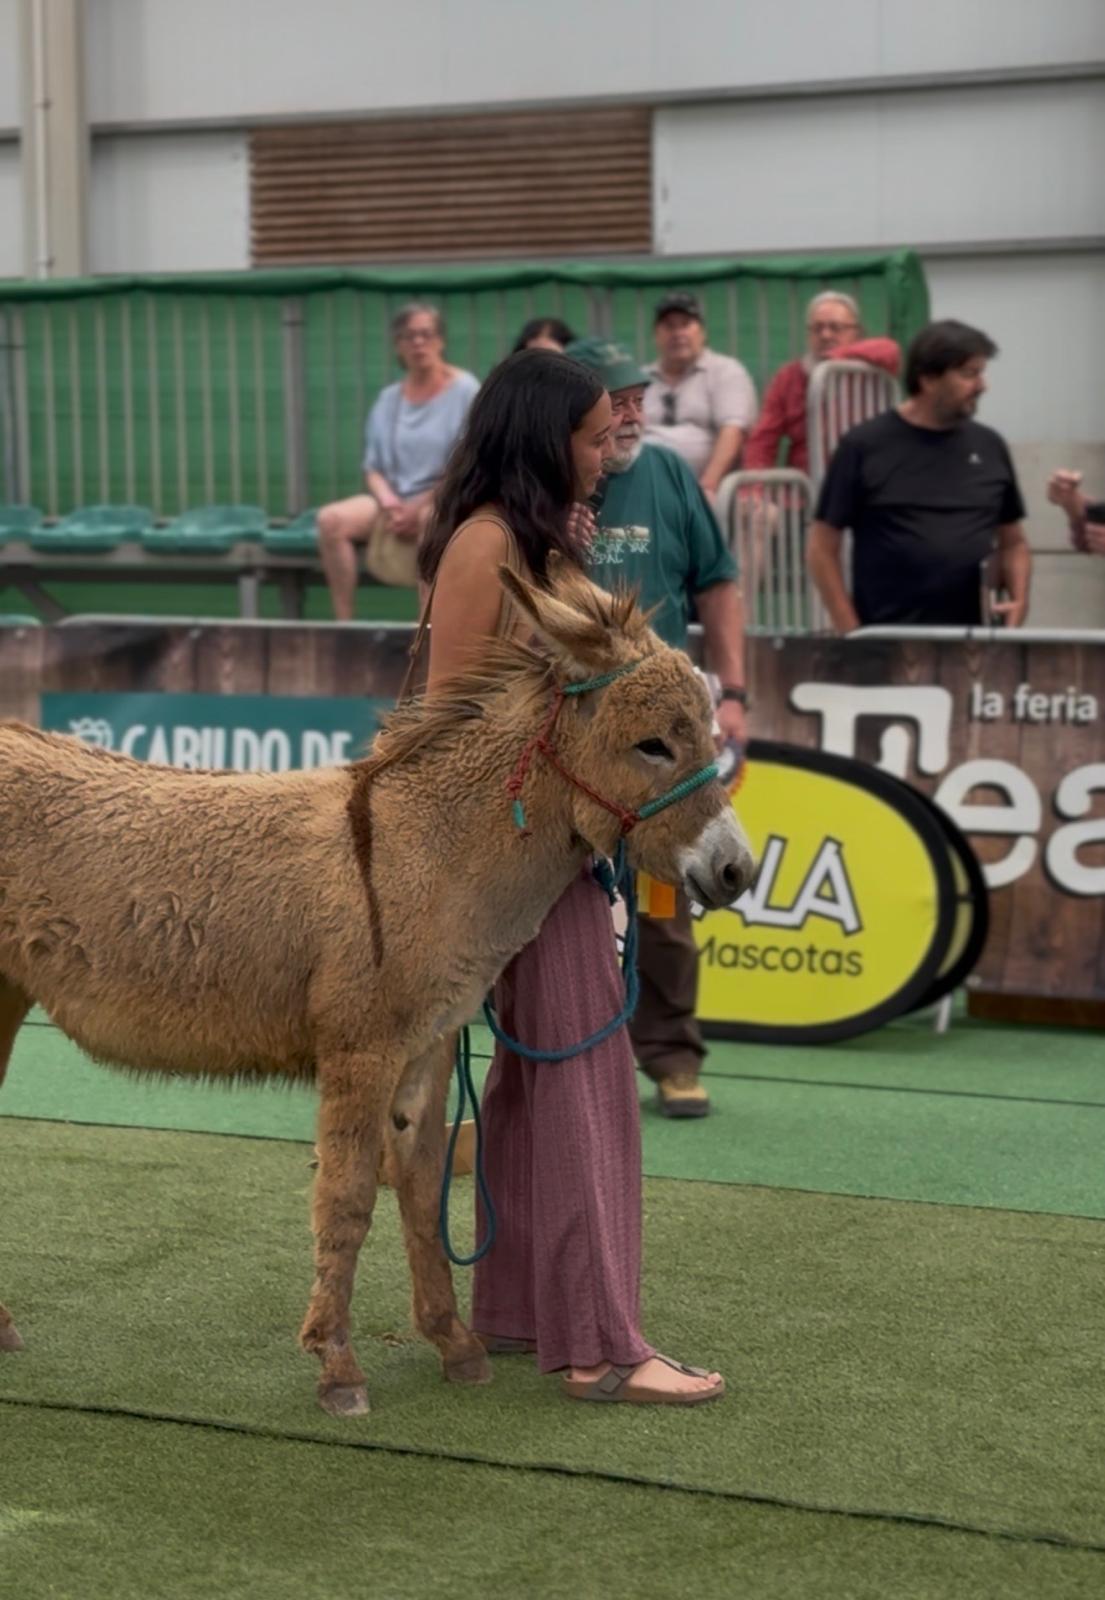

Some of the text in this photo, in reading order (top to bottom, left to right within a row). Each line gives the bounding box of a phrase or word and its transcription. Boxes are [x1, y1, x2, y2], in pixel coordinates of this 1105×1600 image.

[973, 682, 1098, 720] la feria
[122, 725, 291, 772] CABILDO
